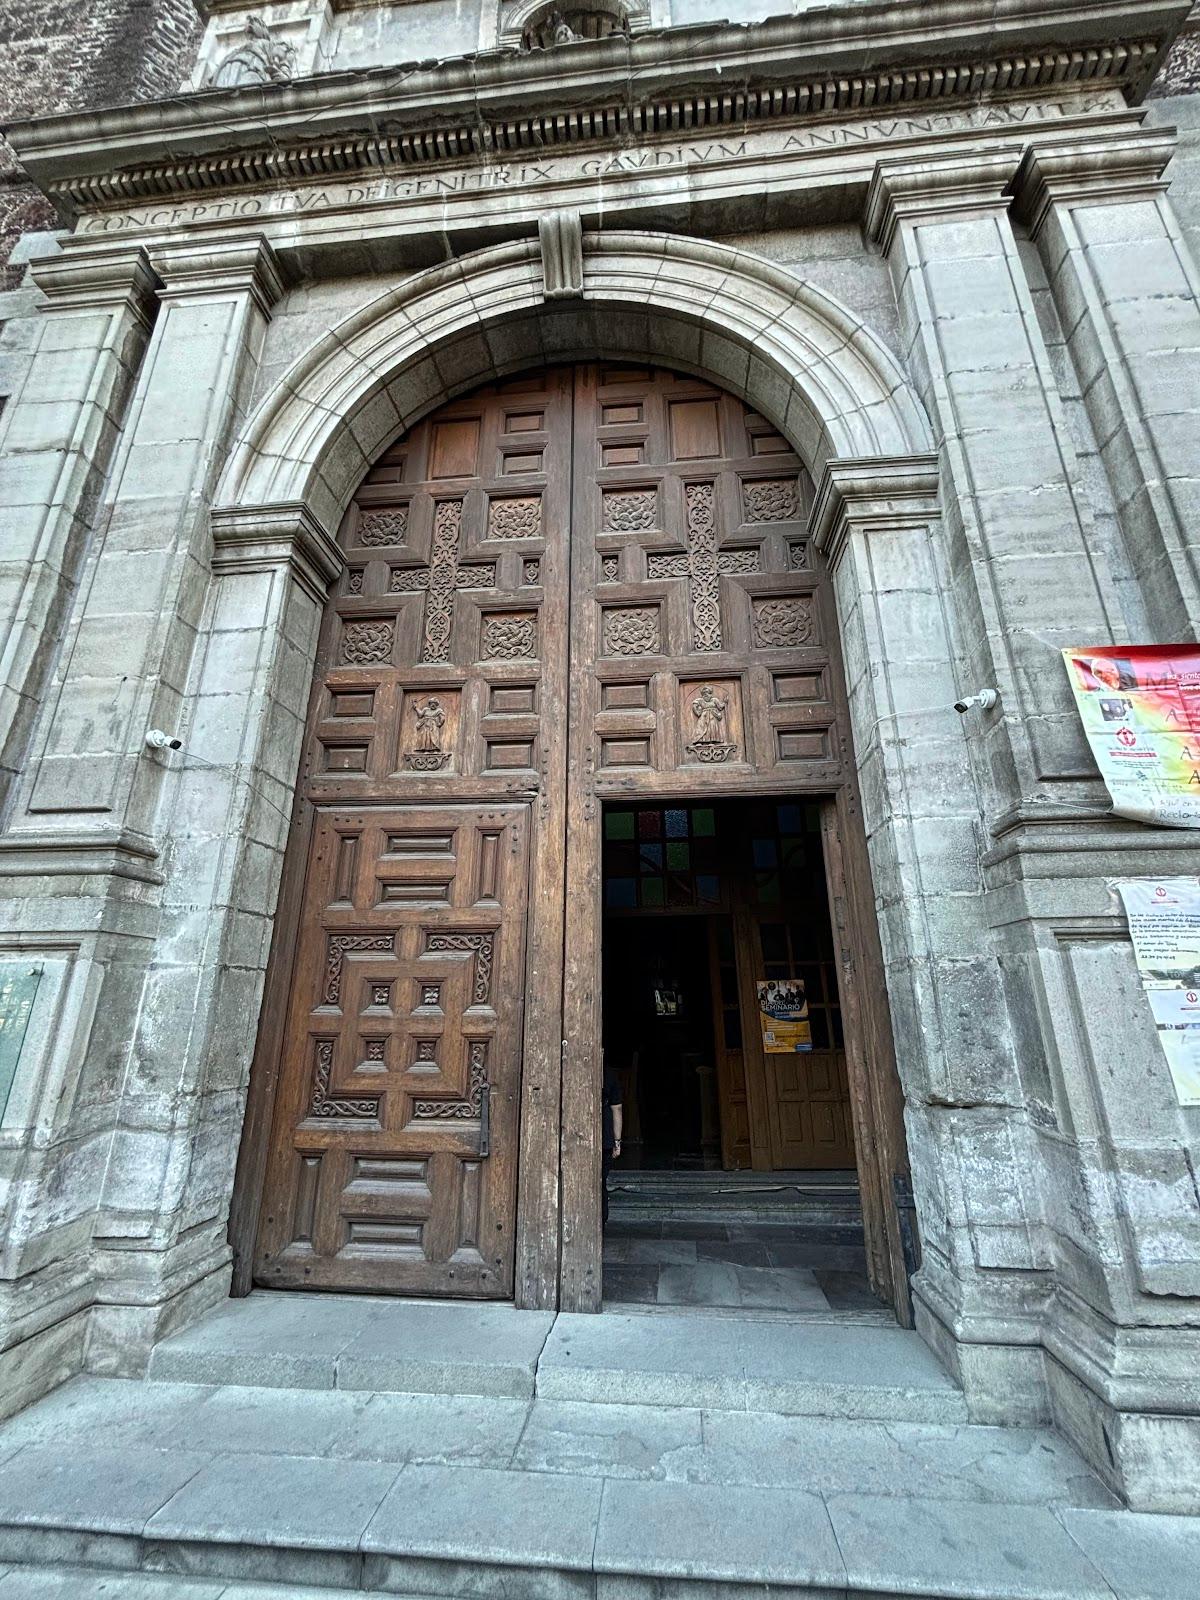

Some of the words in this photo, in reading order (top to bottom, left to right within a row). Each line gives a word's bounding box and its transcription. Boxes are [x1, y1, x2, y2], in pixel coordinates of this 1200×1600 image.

[84, 198, 263, 233] CONCEPTIO
[278, 192, 332, 210] TVA
[581, 141, 747, 175] GAVDIVM
